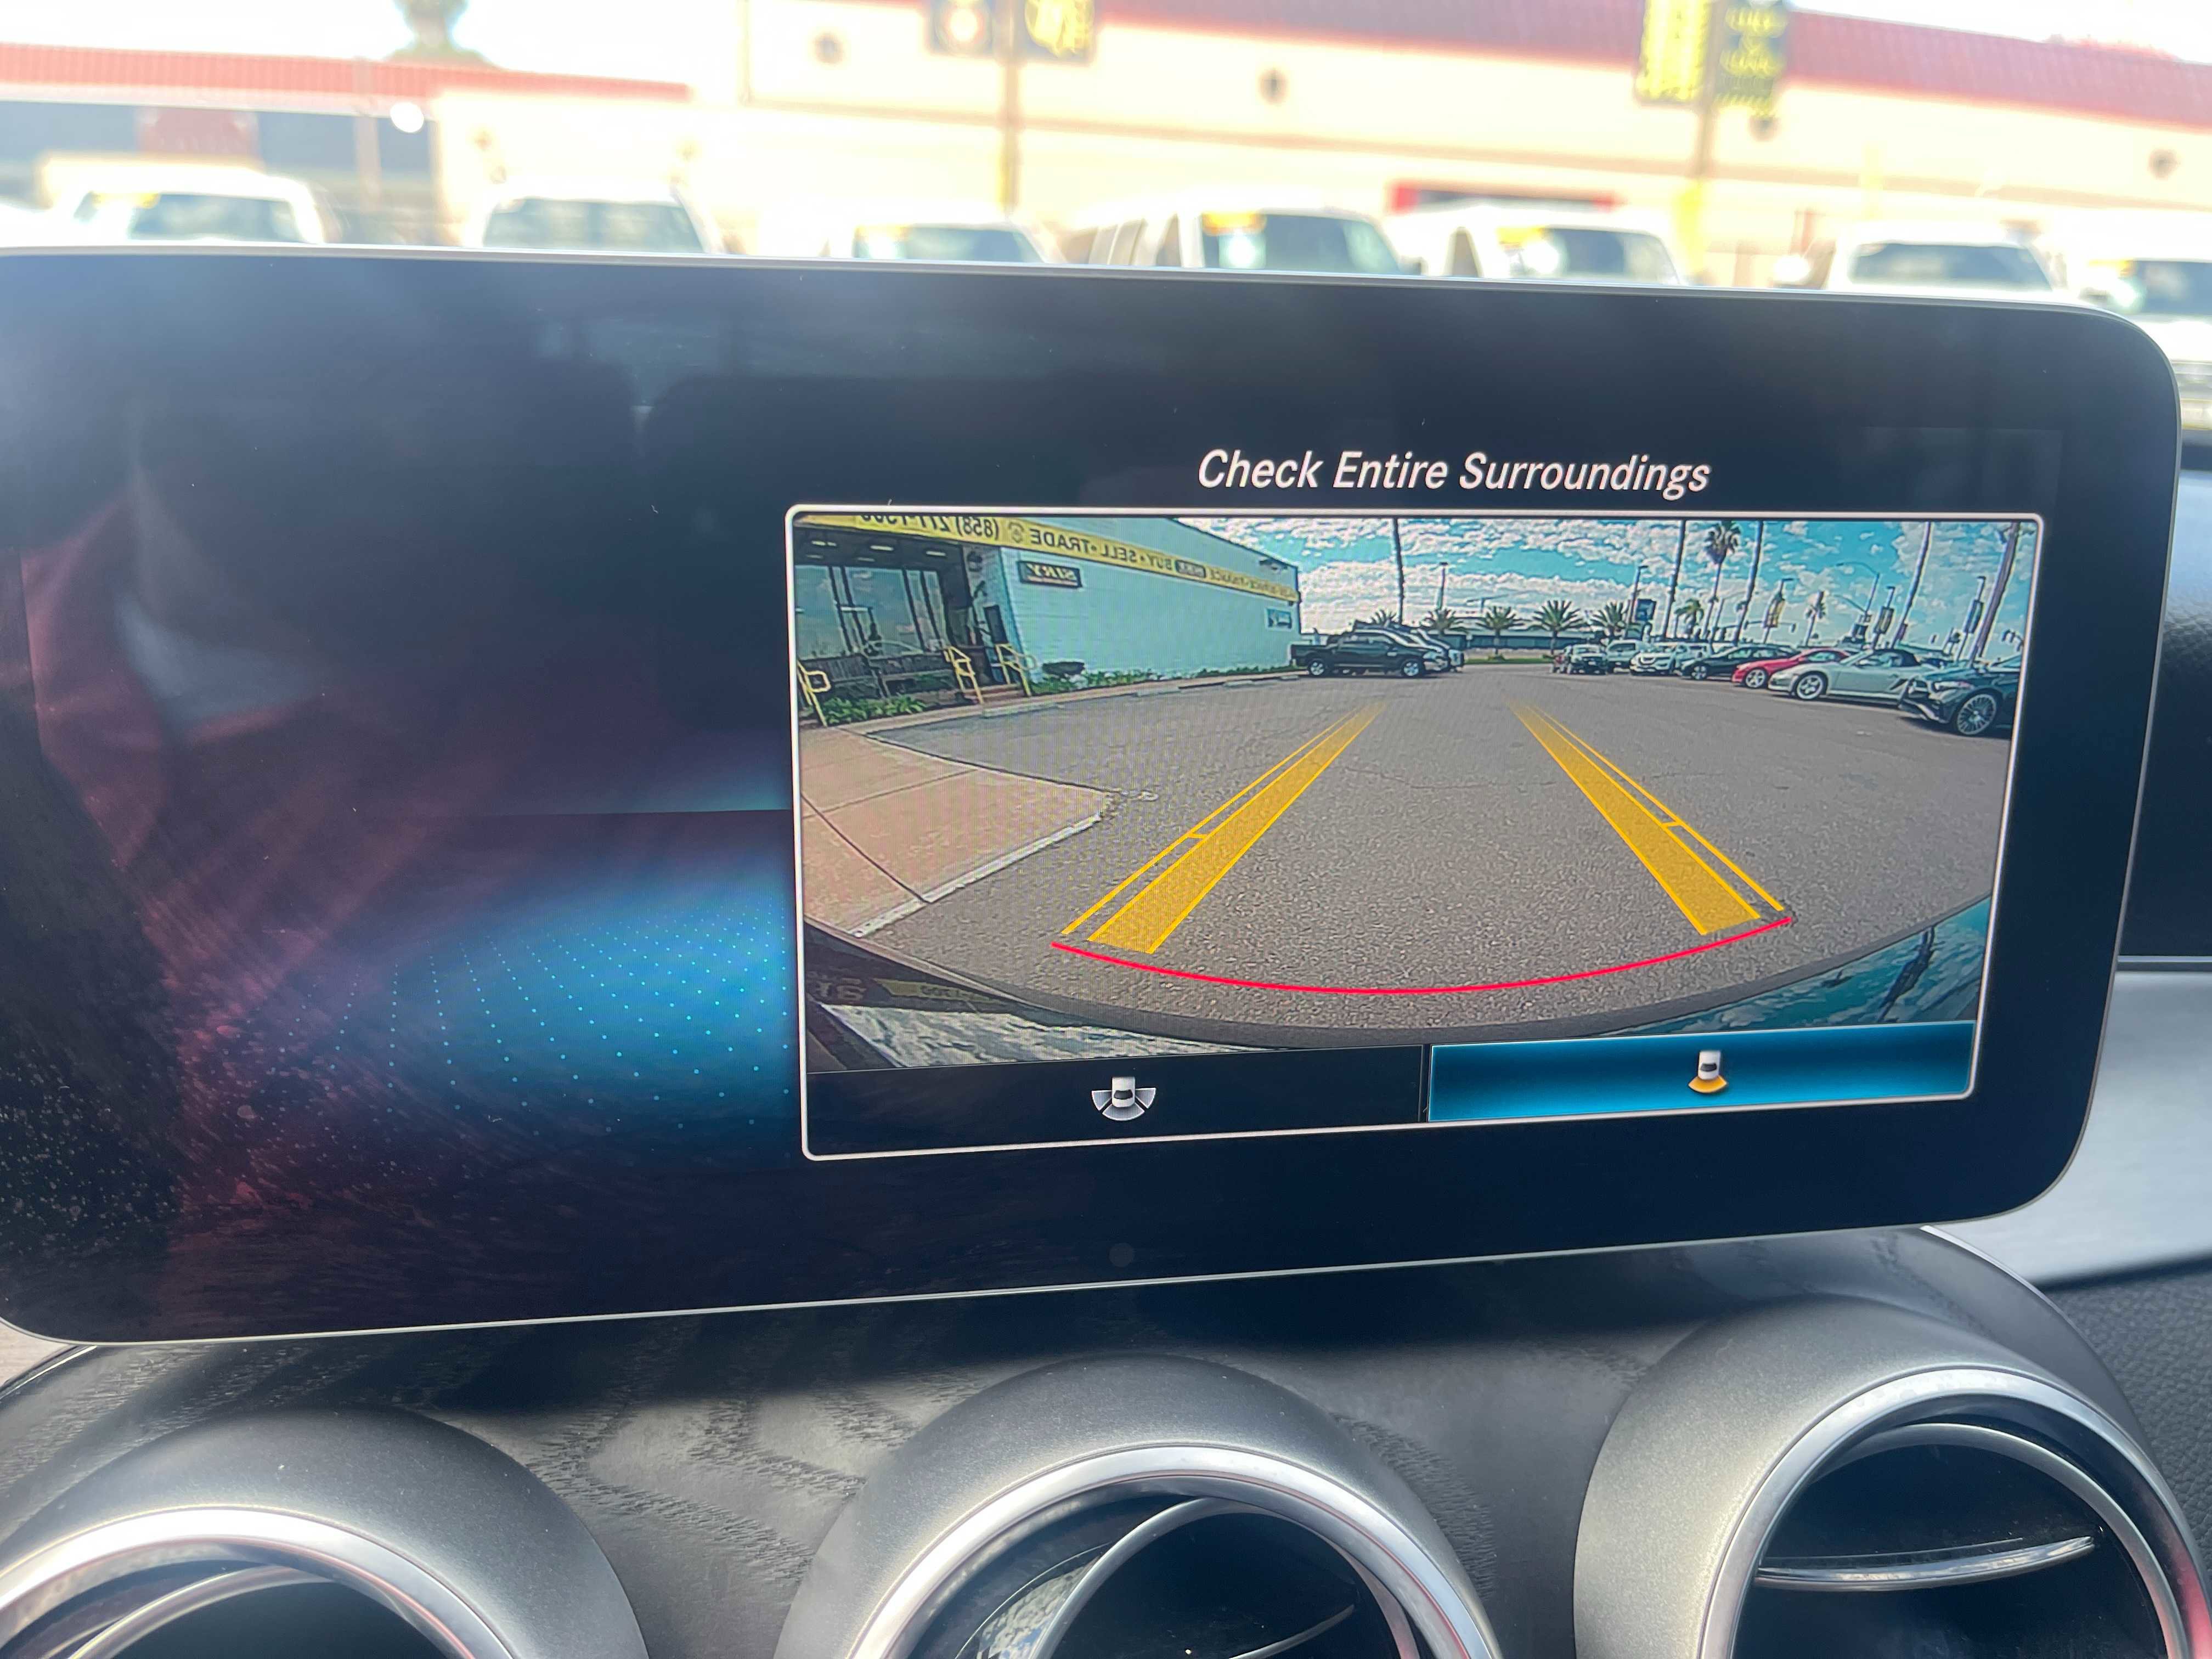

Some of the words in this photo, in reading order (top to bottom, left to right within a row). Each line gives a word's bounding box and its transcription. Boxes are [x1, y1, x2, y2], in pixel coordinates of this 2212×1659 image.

[1198, 449, 1323, 489] Check
[1333, 450, 1448, 490] Entire
[1458, 451, 1712, 501] Surroundings
